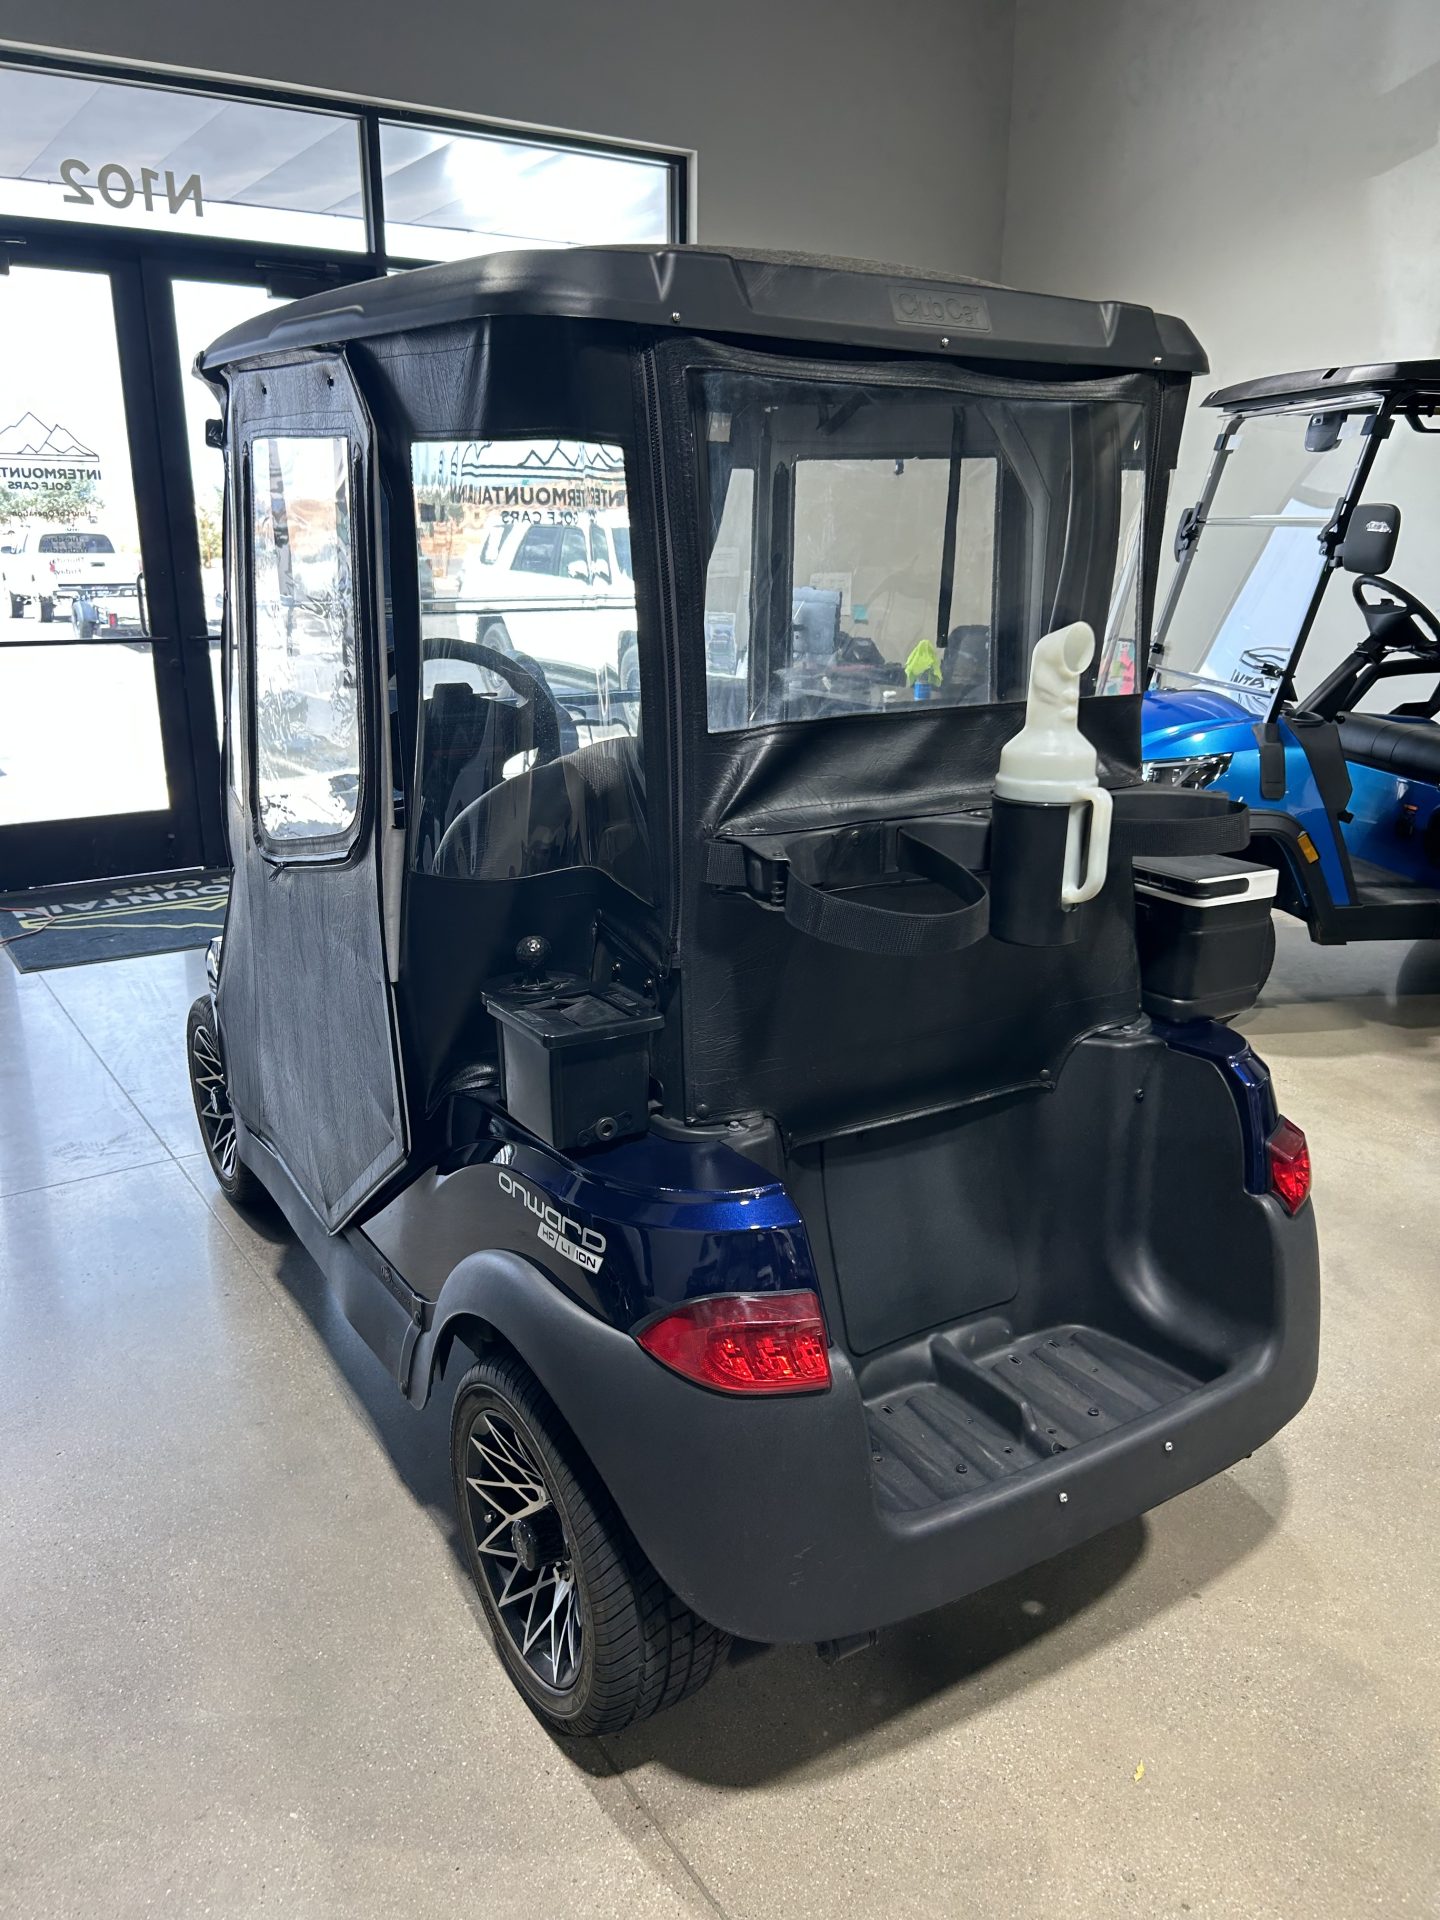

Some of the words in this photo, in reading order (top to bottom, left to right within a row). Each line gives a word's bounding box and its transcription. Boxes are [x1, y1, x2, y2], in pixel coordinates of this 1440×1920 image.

[110, 879, 202, 896] CARS
[11, 884, 230, 919] OUNTAIN
[541, 1226, 555, 1243] HP
